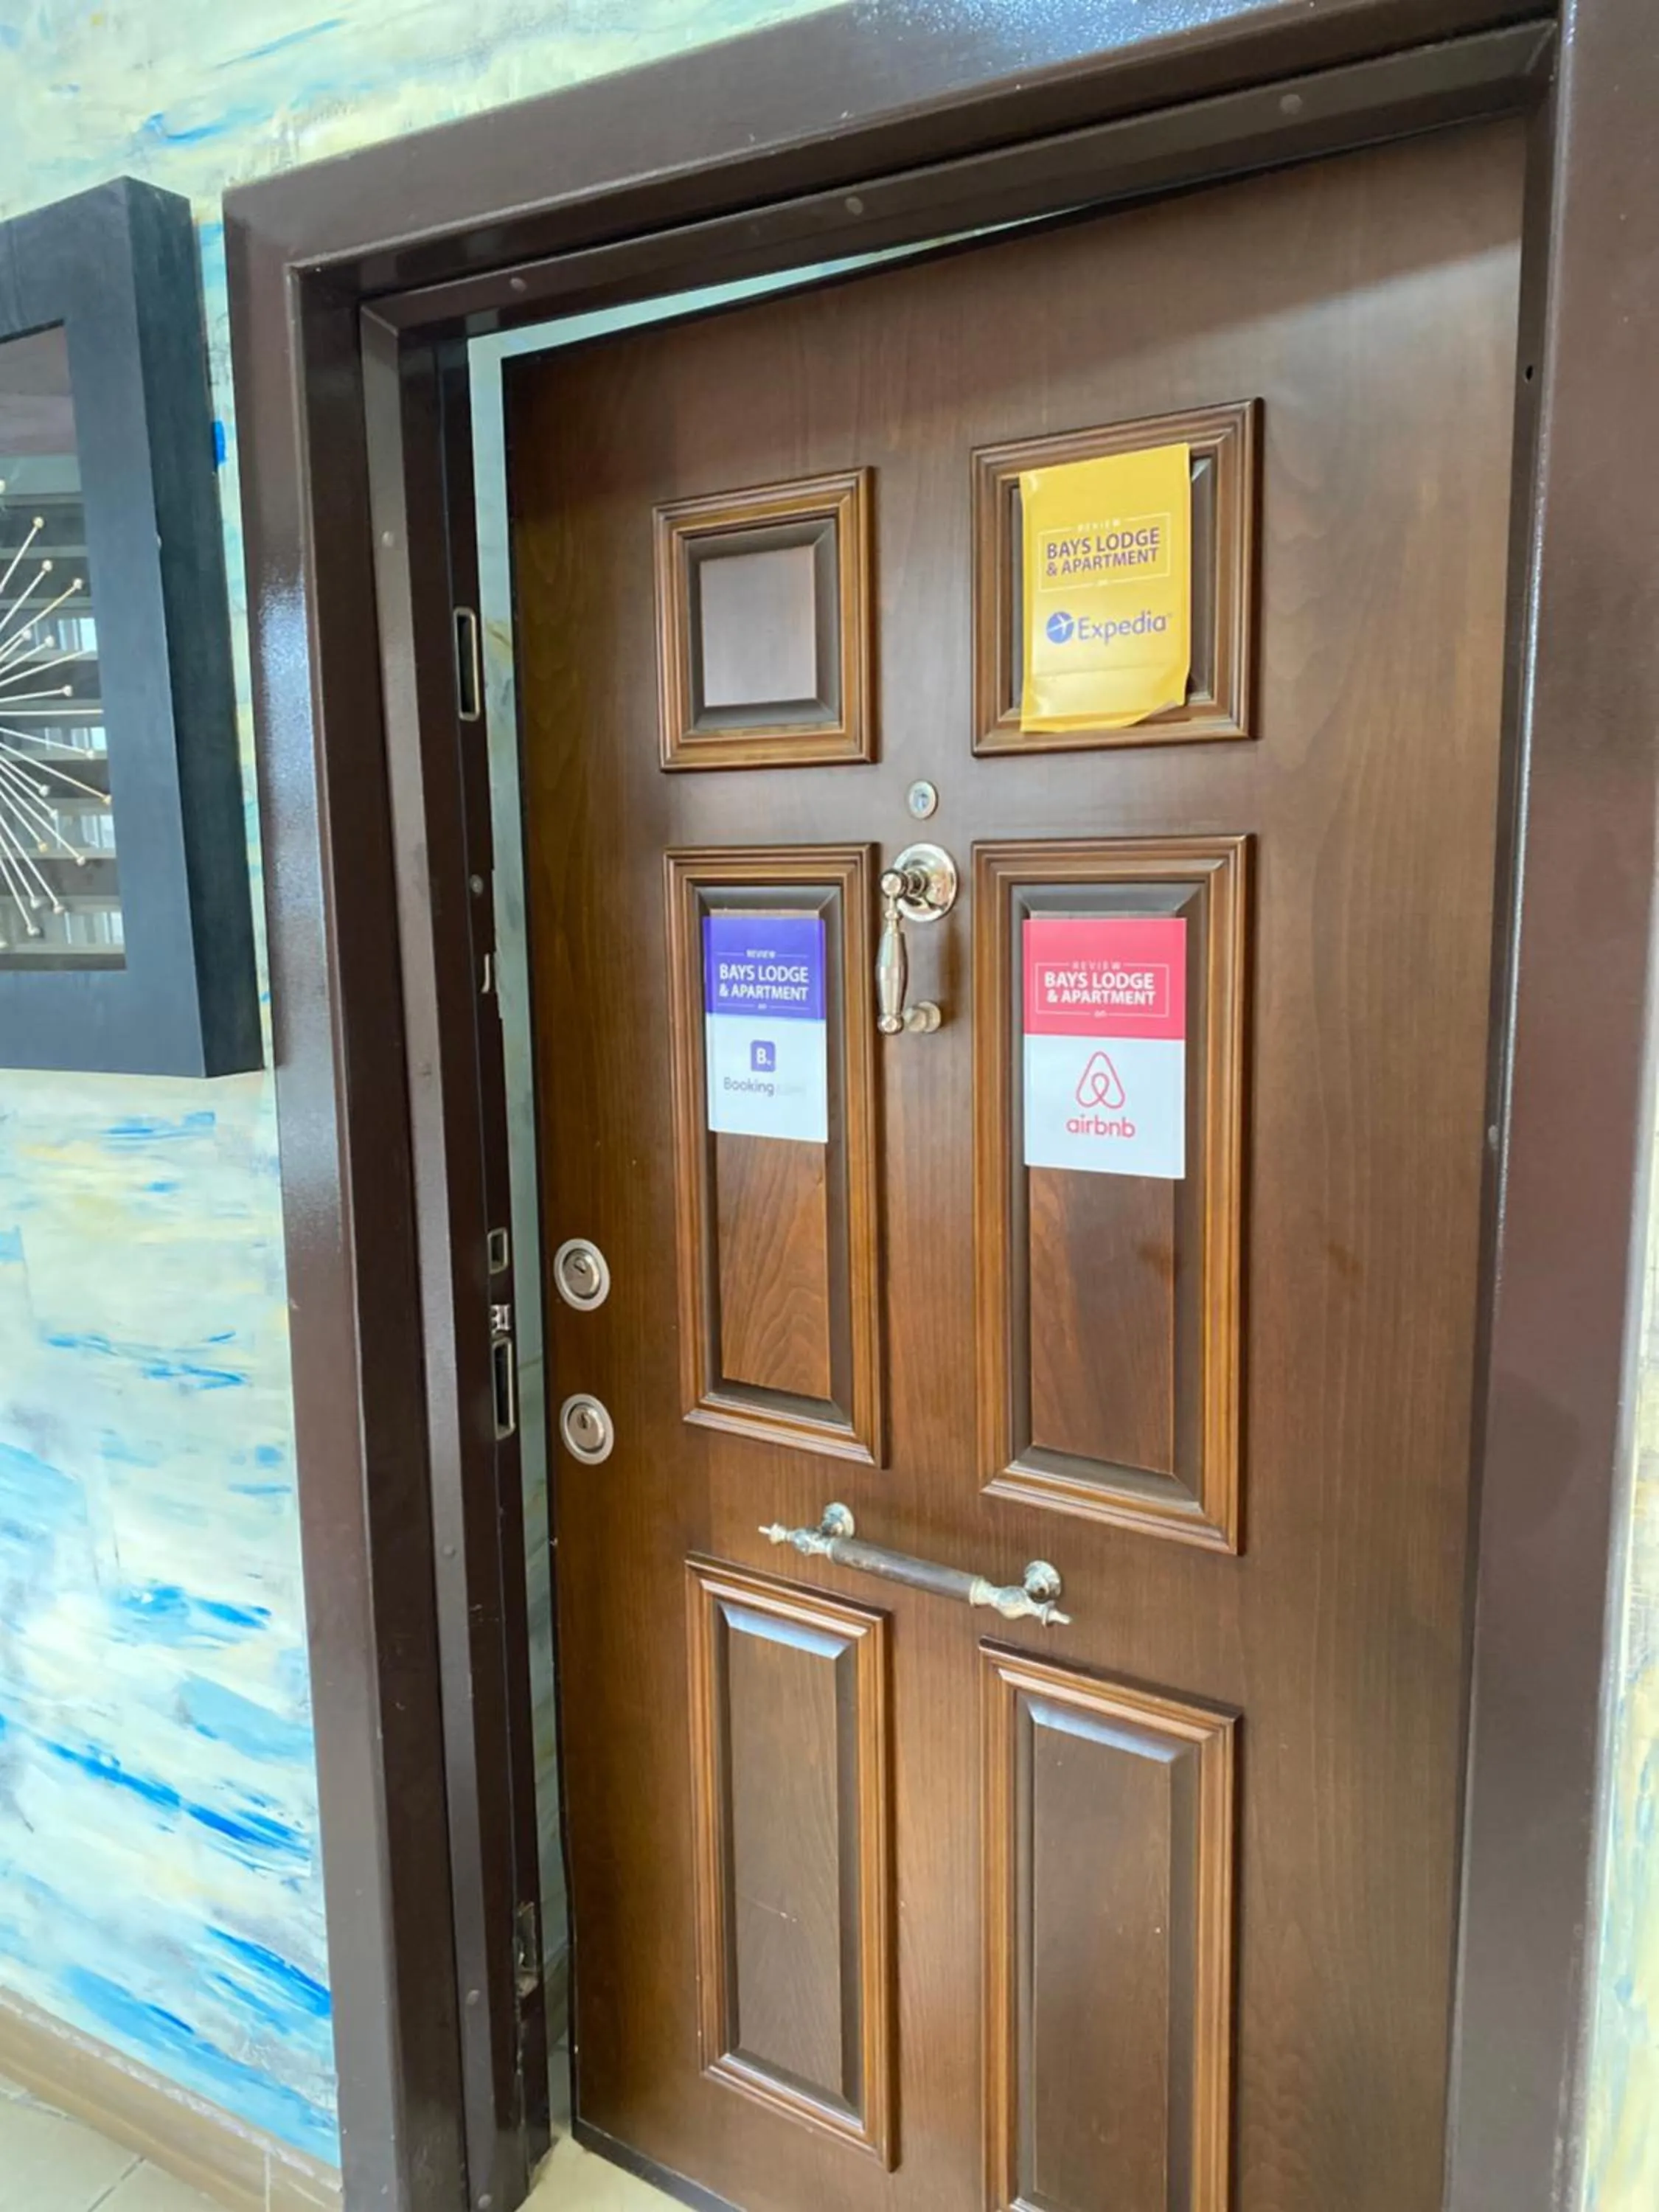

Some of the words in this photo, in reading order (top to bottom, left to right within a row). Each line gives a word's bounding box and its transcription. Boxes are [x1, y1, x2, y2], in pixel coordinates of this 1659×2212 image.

[1046, 538, 1091, 560] BAYS
[1096, 527, 1160, 552] LODGE
[1047, 561, 1057, 576] &
[1061, 547, 1159, 575] APARTMENT
[1078, 611, 1166, 645] Expedia
[719, 963, 755, 981] BAYS
[758, 964, 809, 984] LODGE
[1072, 961, 1121, 970] REVIEW
[1044, 971, 1088, 988] BAYS
[1092, 972, 1155, 990] LODGE
[719, 983, 729, 998] &
[731, 984, 809, 1002] APARTMENT
[1047, 989, 1058, 1004] &
[1060, 990, 1156, 1006] APARTMENT
[1066, 1113, 1136, 1138] airbnb
